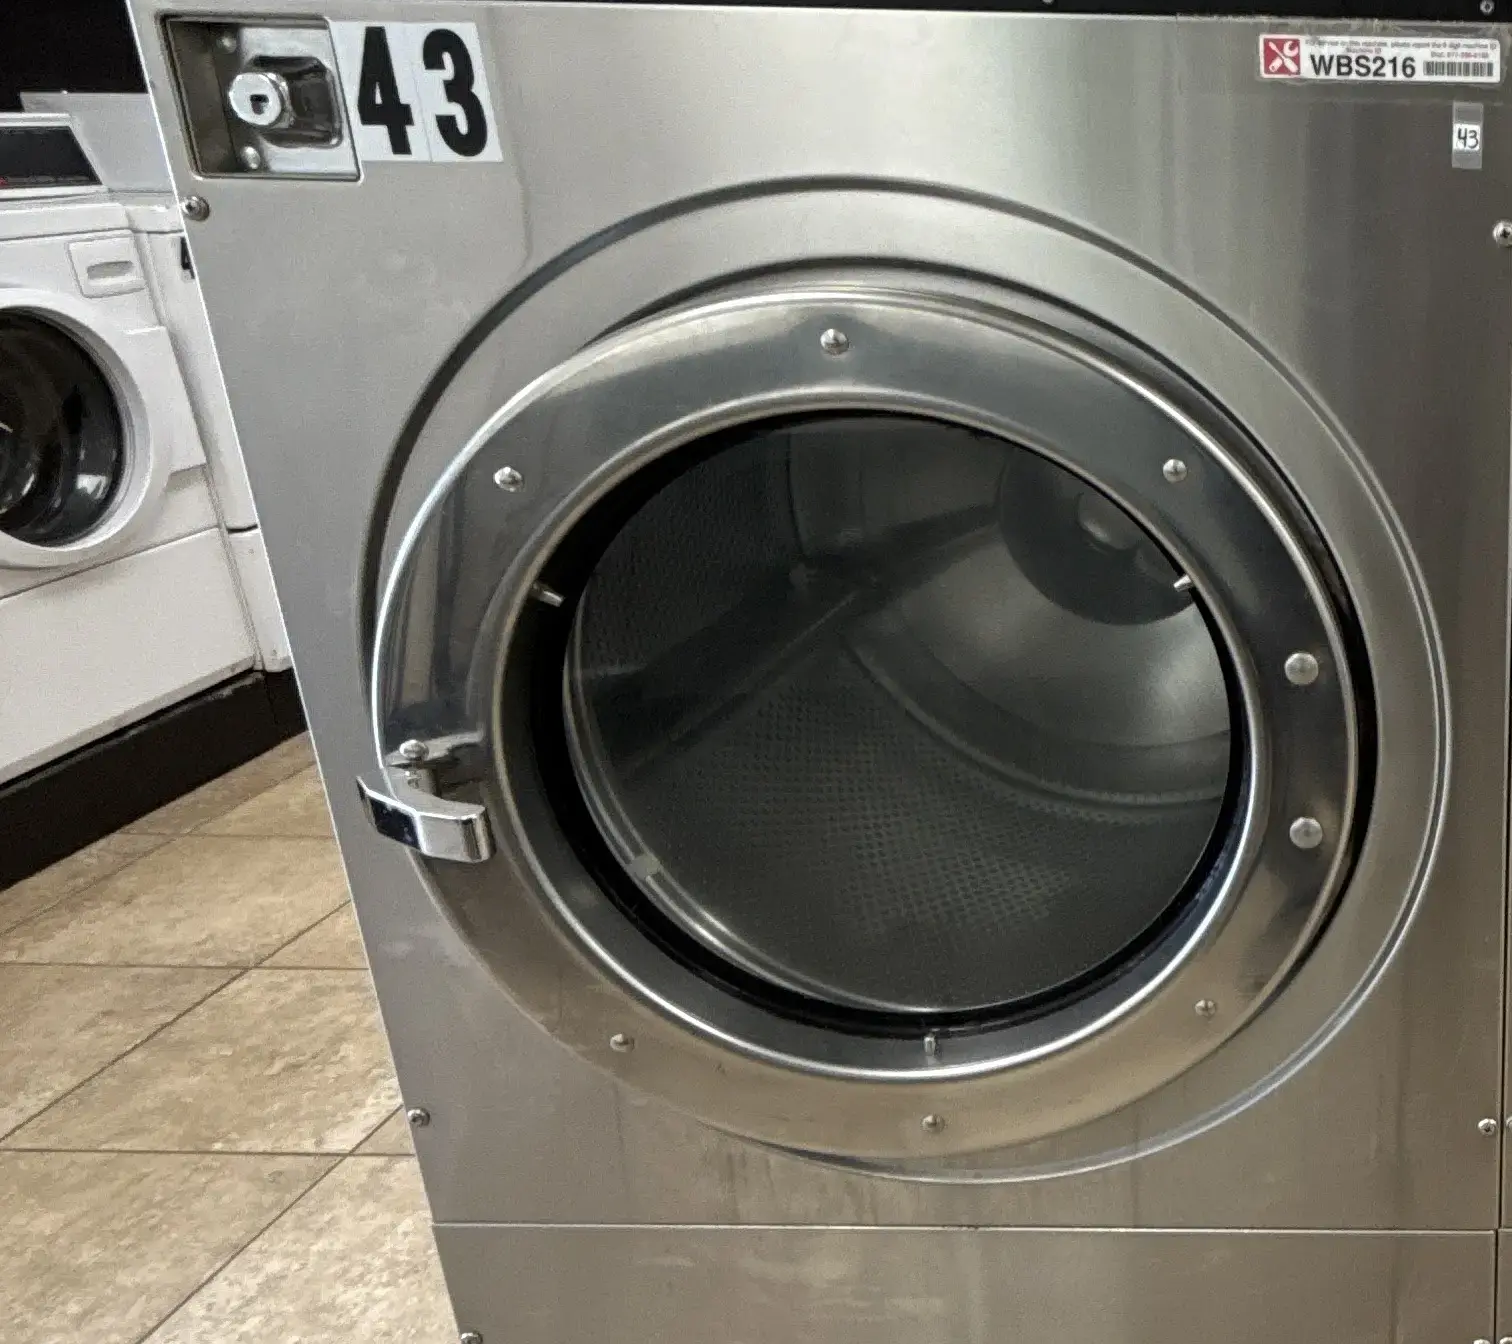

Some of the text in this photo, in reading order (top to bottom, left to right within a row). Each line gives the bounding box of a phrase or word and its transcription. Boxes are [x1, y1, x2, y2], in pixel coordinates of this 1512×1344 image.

[1310, 54, 1416, 78] WBS216
[357, 26, 488, 157] 43
[1457, 127, 1480, 149] 43
